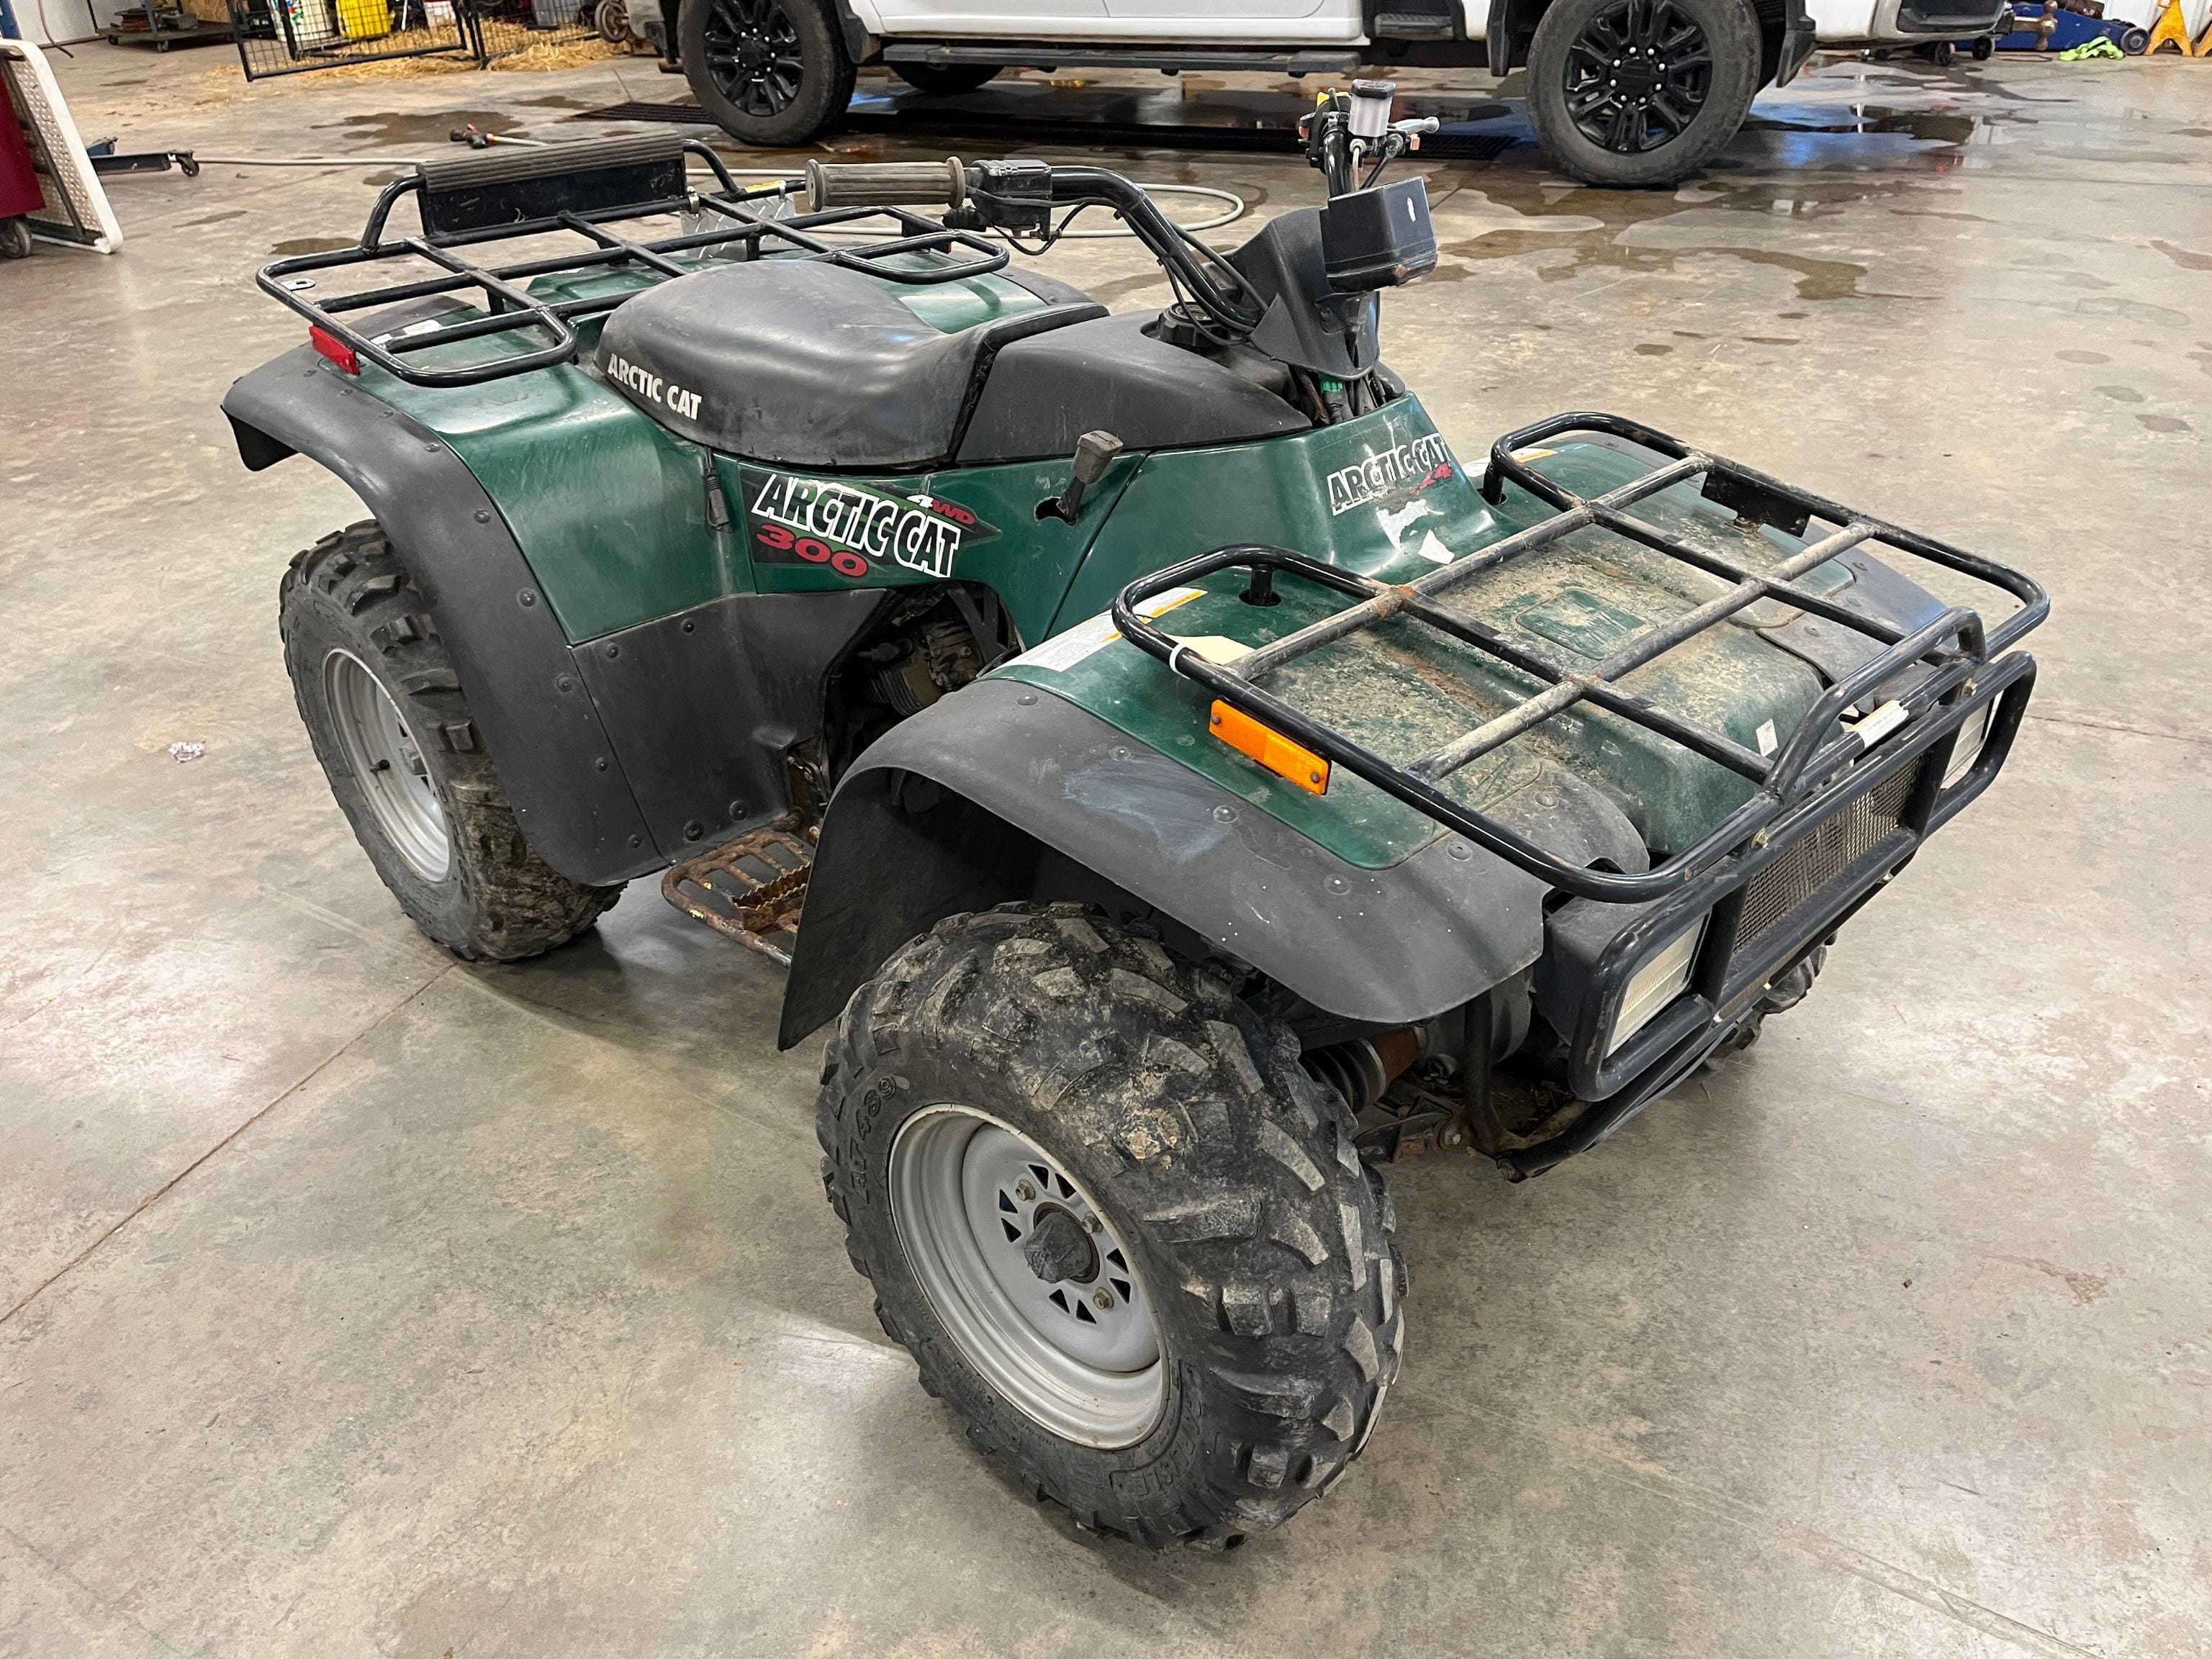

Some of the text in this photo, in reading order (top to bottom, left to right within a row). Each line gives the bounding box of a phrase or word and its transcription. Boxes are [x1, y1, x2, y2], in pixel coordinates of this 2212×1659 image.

[608, 353, 702, 420] ARCTIC CAT
[1327, 444, 1416, 516] ARCTIC
[1412, 432, 1451, 472] CAT
[751, 474, 962, 577] ARCTIC CAT
[907, 494, 975, 525] 4WD
[757, 524, 869, 577] 300
